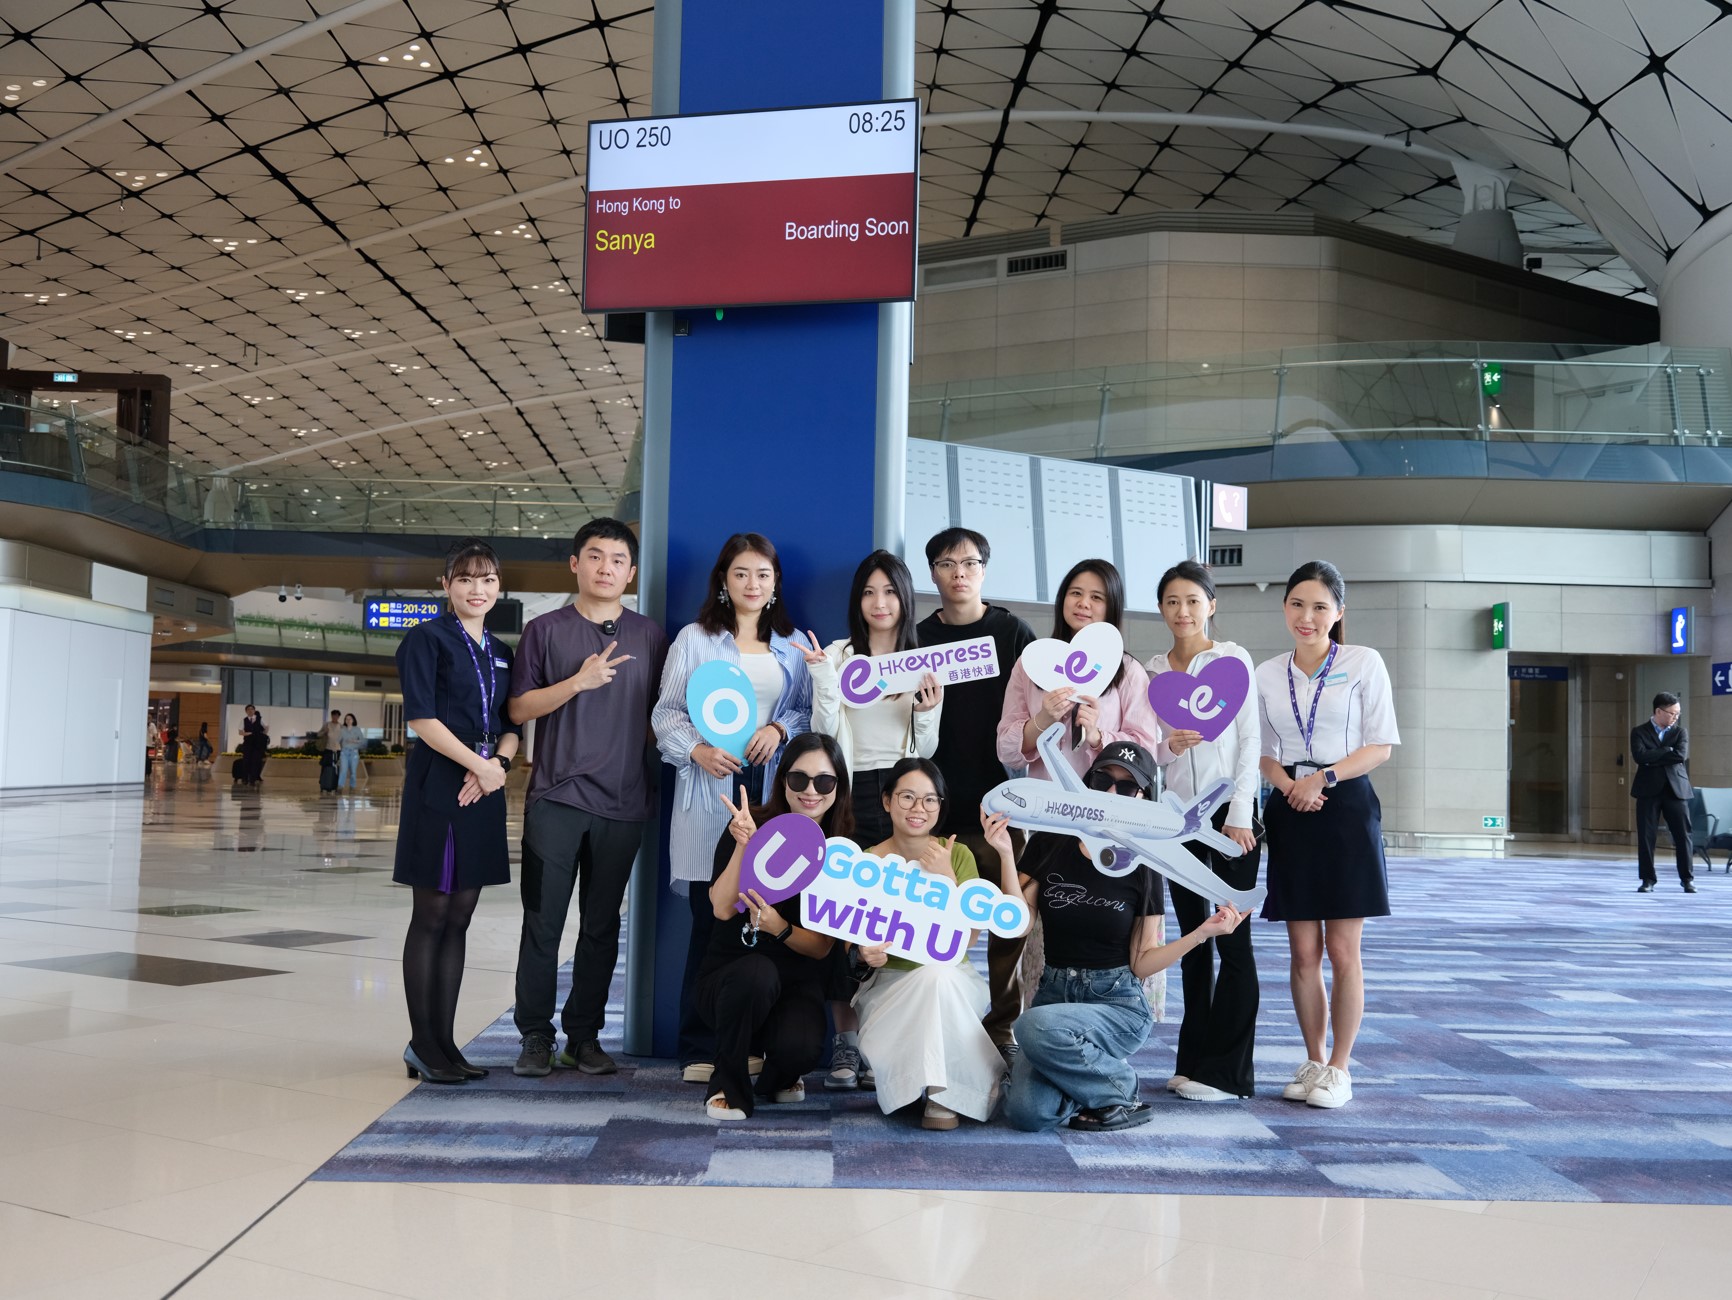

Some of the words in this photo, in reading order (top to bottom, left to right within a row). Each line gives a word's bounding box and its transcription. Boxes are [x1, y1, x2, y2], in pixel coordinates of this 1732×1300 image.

[848, 109, 906, 134] 08:25
[598, 128, 630, 151] UO
[636, 126, 672, 149] 250
[596, 198, 629, 216] Hong
[632, 197, 665, 214] Kong
[669, 196, 681, 210] to
[595, 229, 655, 255] Sanya
[785, 219, 860, 242] Boarding
[864, 217, 909, 237] Soon
[402, 603, 438, 615] 201-210
[947, 663, 996, 682] 香港快運
[1118, 747, 1136, 762] NY
[752, 830, 811, 891] U
[821, 843, 950, 911] Gotta
[959, 885, 1022, 931] Go
[807, 893, 915, 951] with
[926, 922, 963, 962] U
